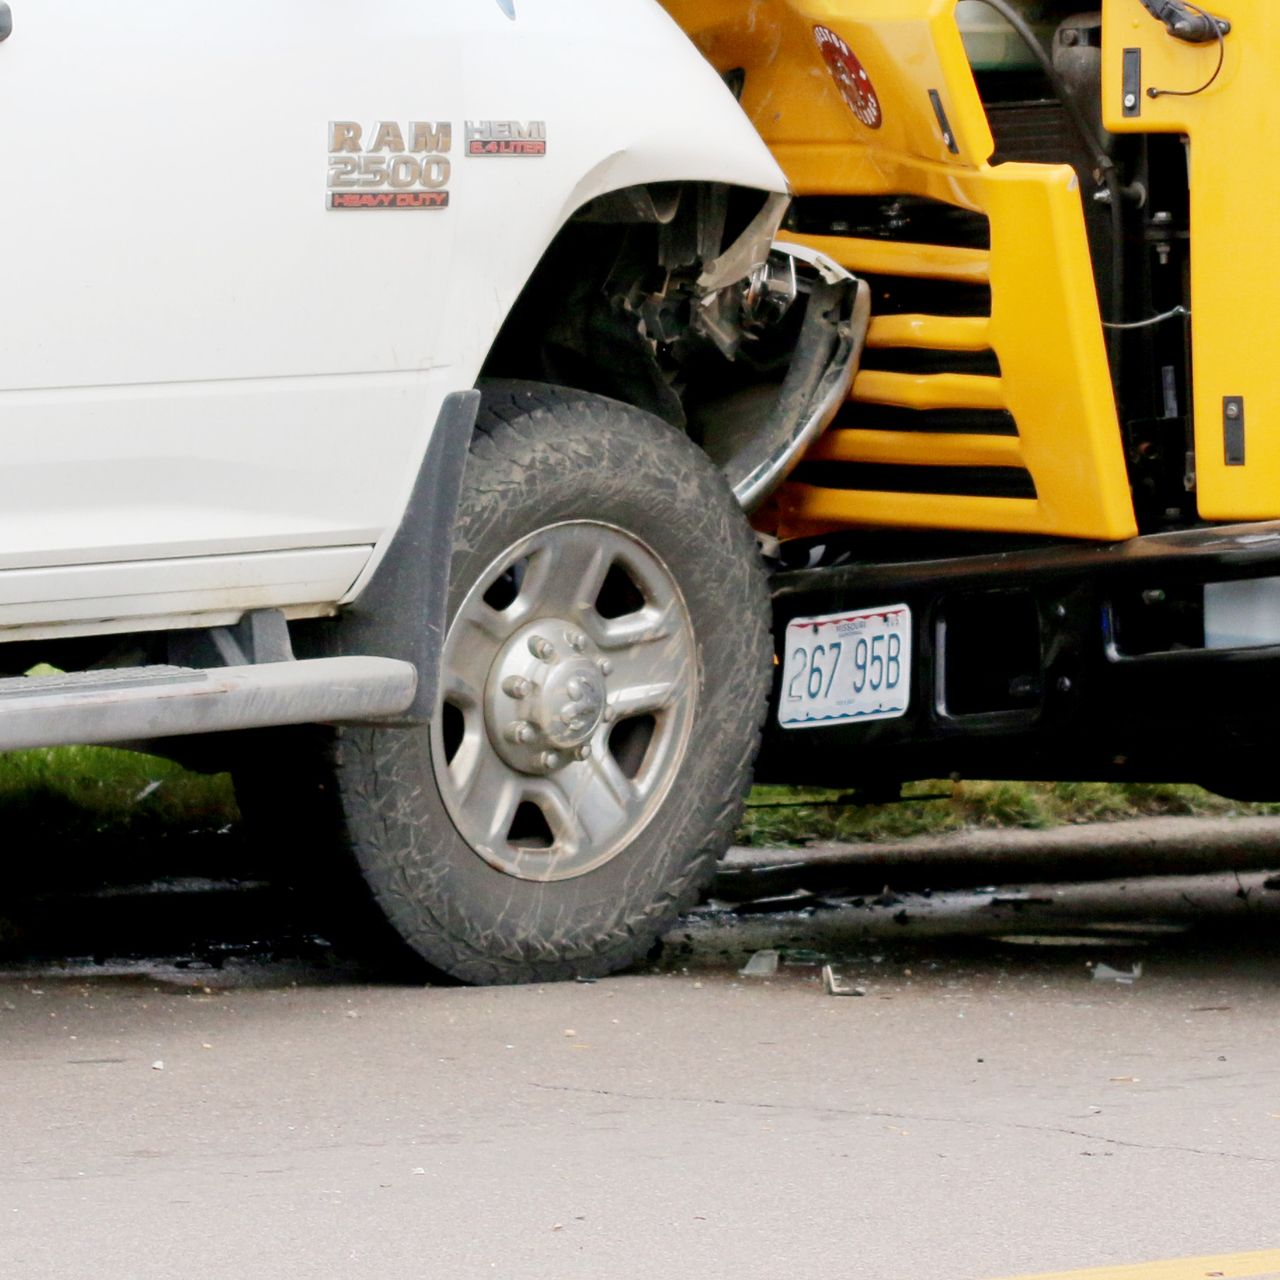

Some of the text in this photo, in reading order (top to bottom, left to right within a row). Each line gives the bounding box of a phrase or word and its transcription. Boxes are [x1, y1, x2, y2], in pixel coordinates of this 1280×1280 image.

[327, 120, 452, 154] RAM
[464, 120, 547, 139] HEMI
[500, 140, 545, 154] LITER
[326, 154, 451, 188] 2500
[333, 192, 447, 208] HEAVY DUTY
[787, 632, 901, 702] 267 95B
